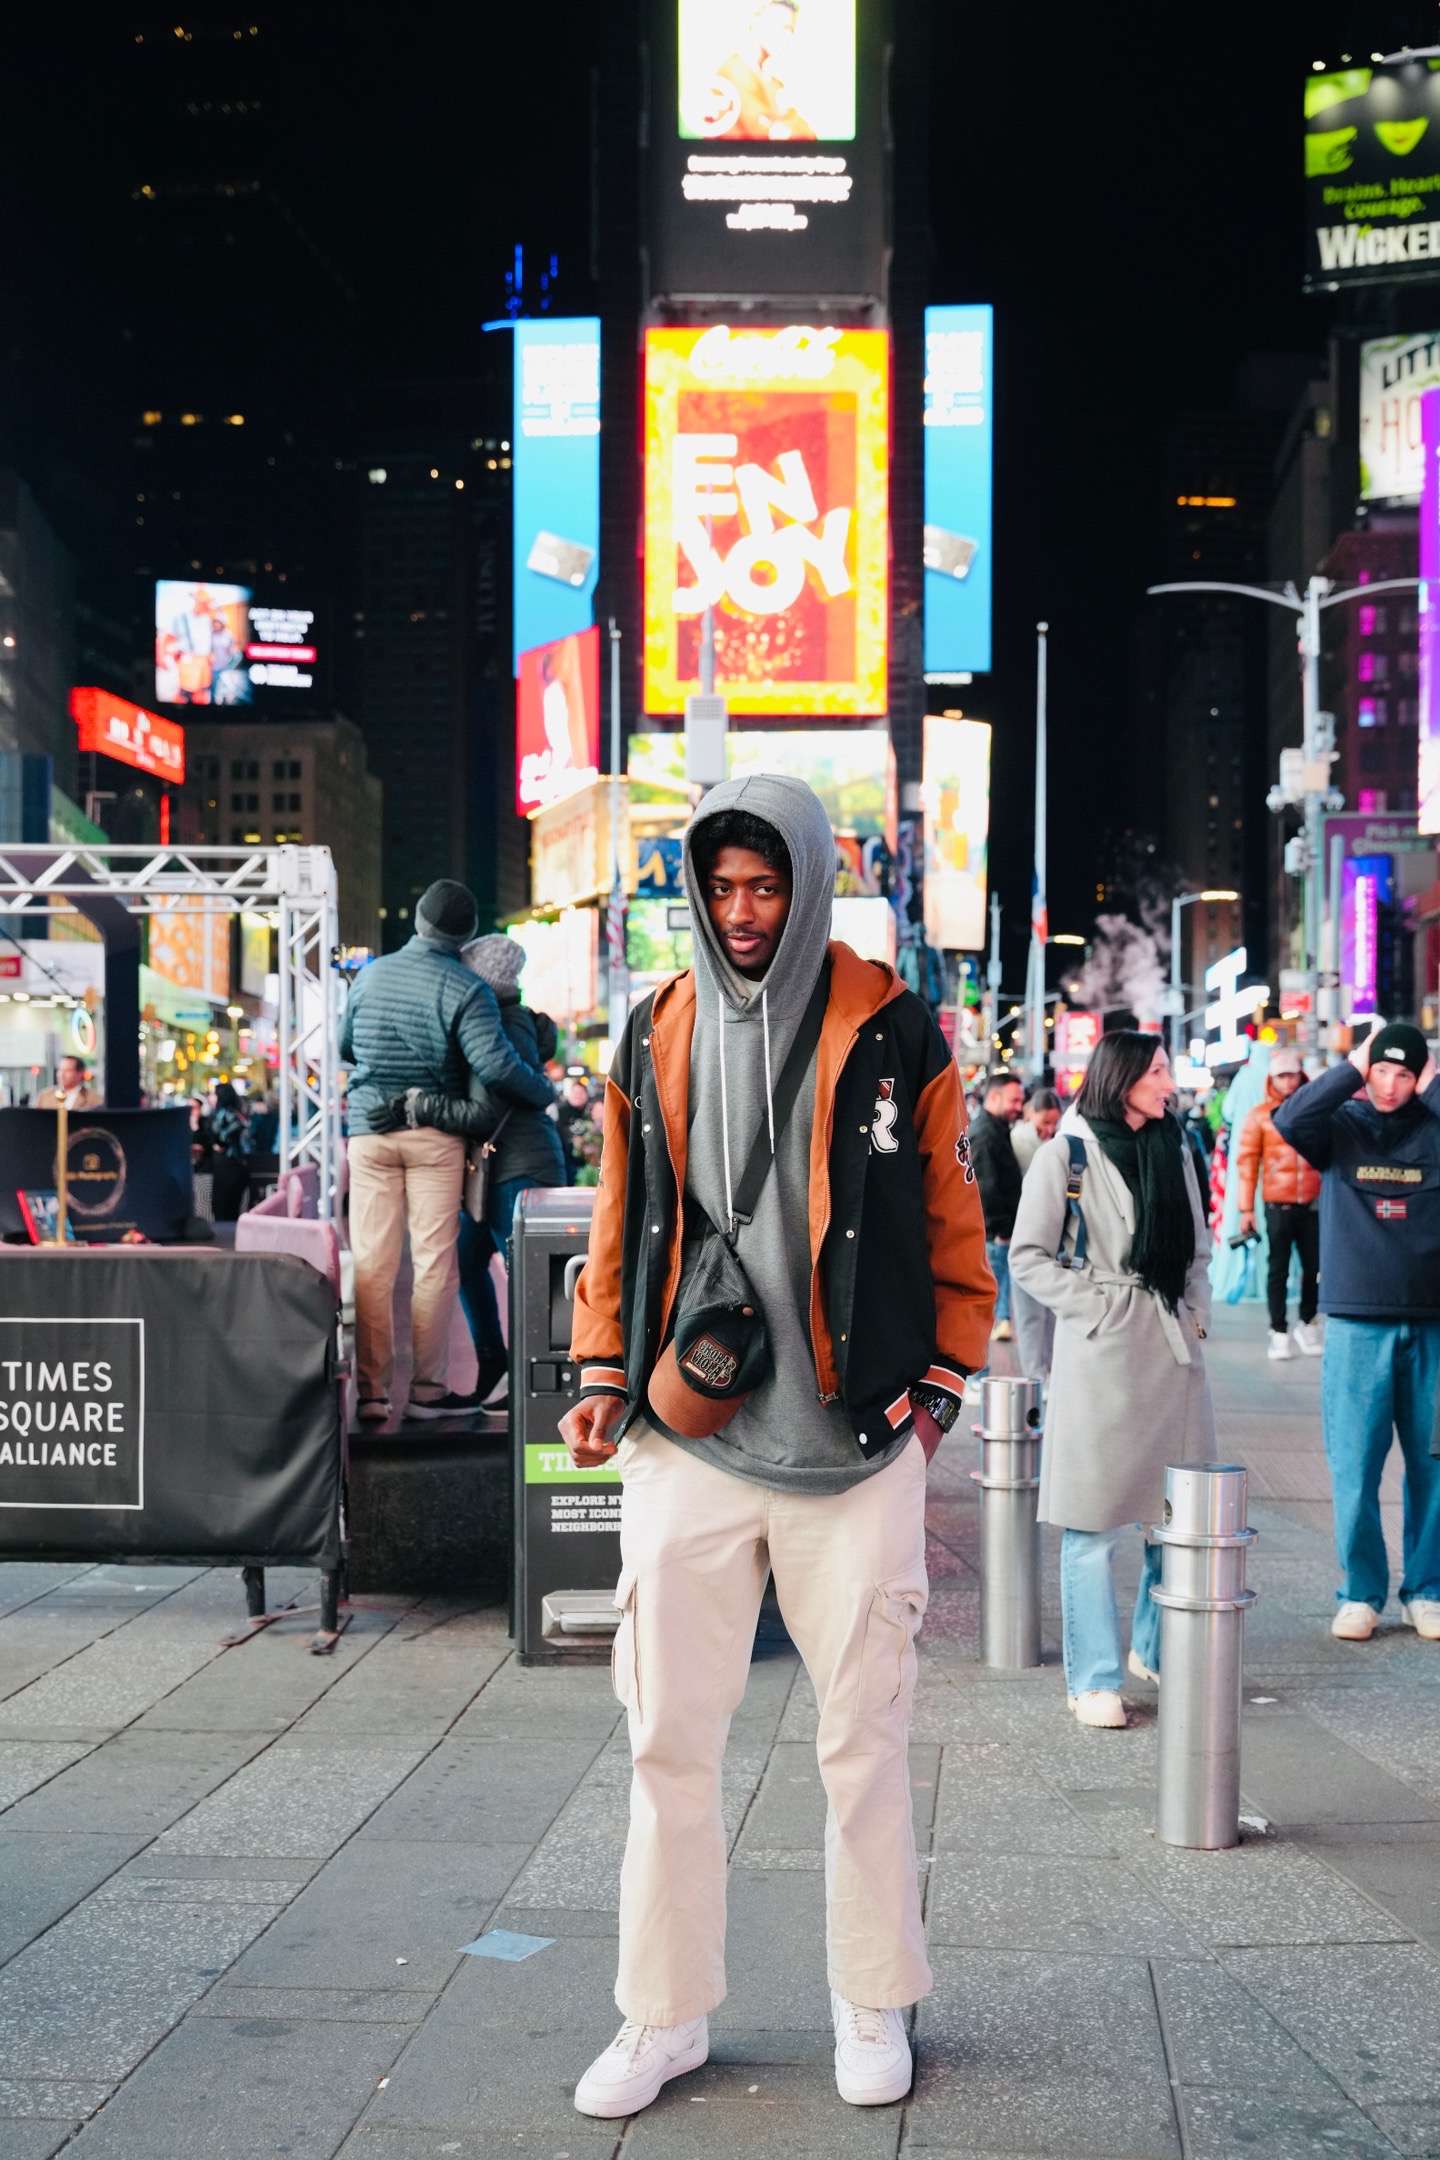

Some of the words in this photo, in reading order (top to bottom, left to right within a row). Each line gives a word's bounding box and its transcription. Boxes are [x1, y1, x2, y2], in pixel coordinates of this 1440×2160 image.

[672, 432, 820, 535] EN
[672, 506, 853, 615] JOY
[1, 1361, 113, 1392] TIMES
[0, 1401, 125, 1437] SQUARE
[0, 1442, 117, 1466] ALLIANCE
[551, 1495, 606, 1506] EXPLORE
[551, 1508, 587, 1519] MOST
